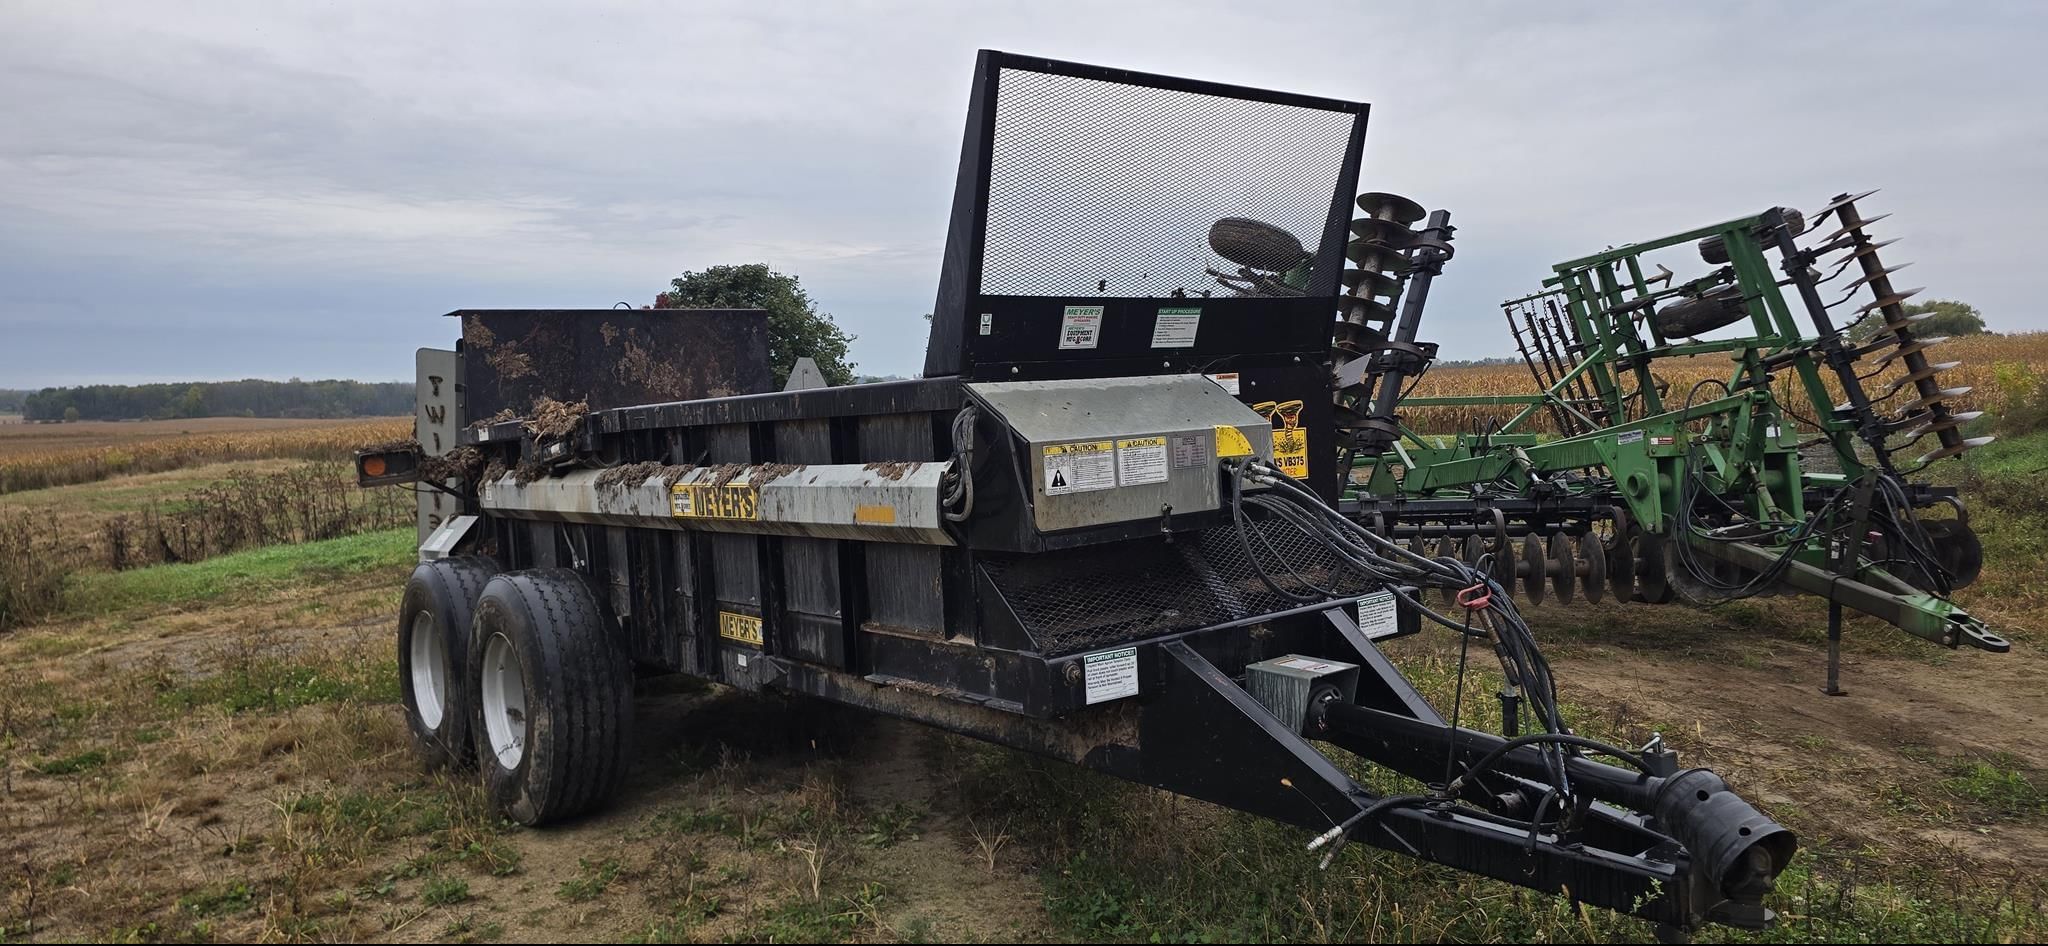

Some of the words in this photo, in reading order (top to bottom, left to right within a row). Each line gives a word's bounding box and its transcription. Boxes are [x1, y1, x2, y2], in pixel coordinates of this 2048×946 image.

[1066, 308, 1101, 316] MEYER'S
[1132, 439, 1157, 448] CAUTION
[1069, 444, 1098, 453] CAUTION
[1284, 456, 1304, 467] VB375
[721, 615, 758, 640] MEYER'S
[1087, 653, 1113, 663] IMPORTANT
